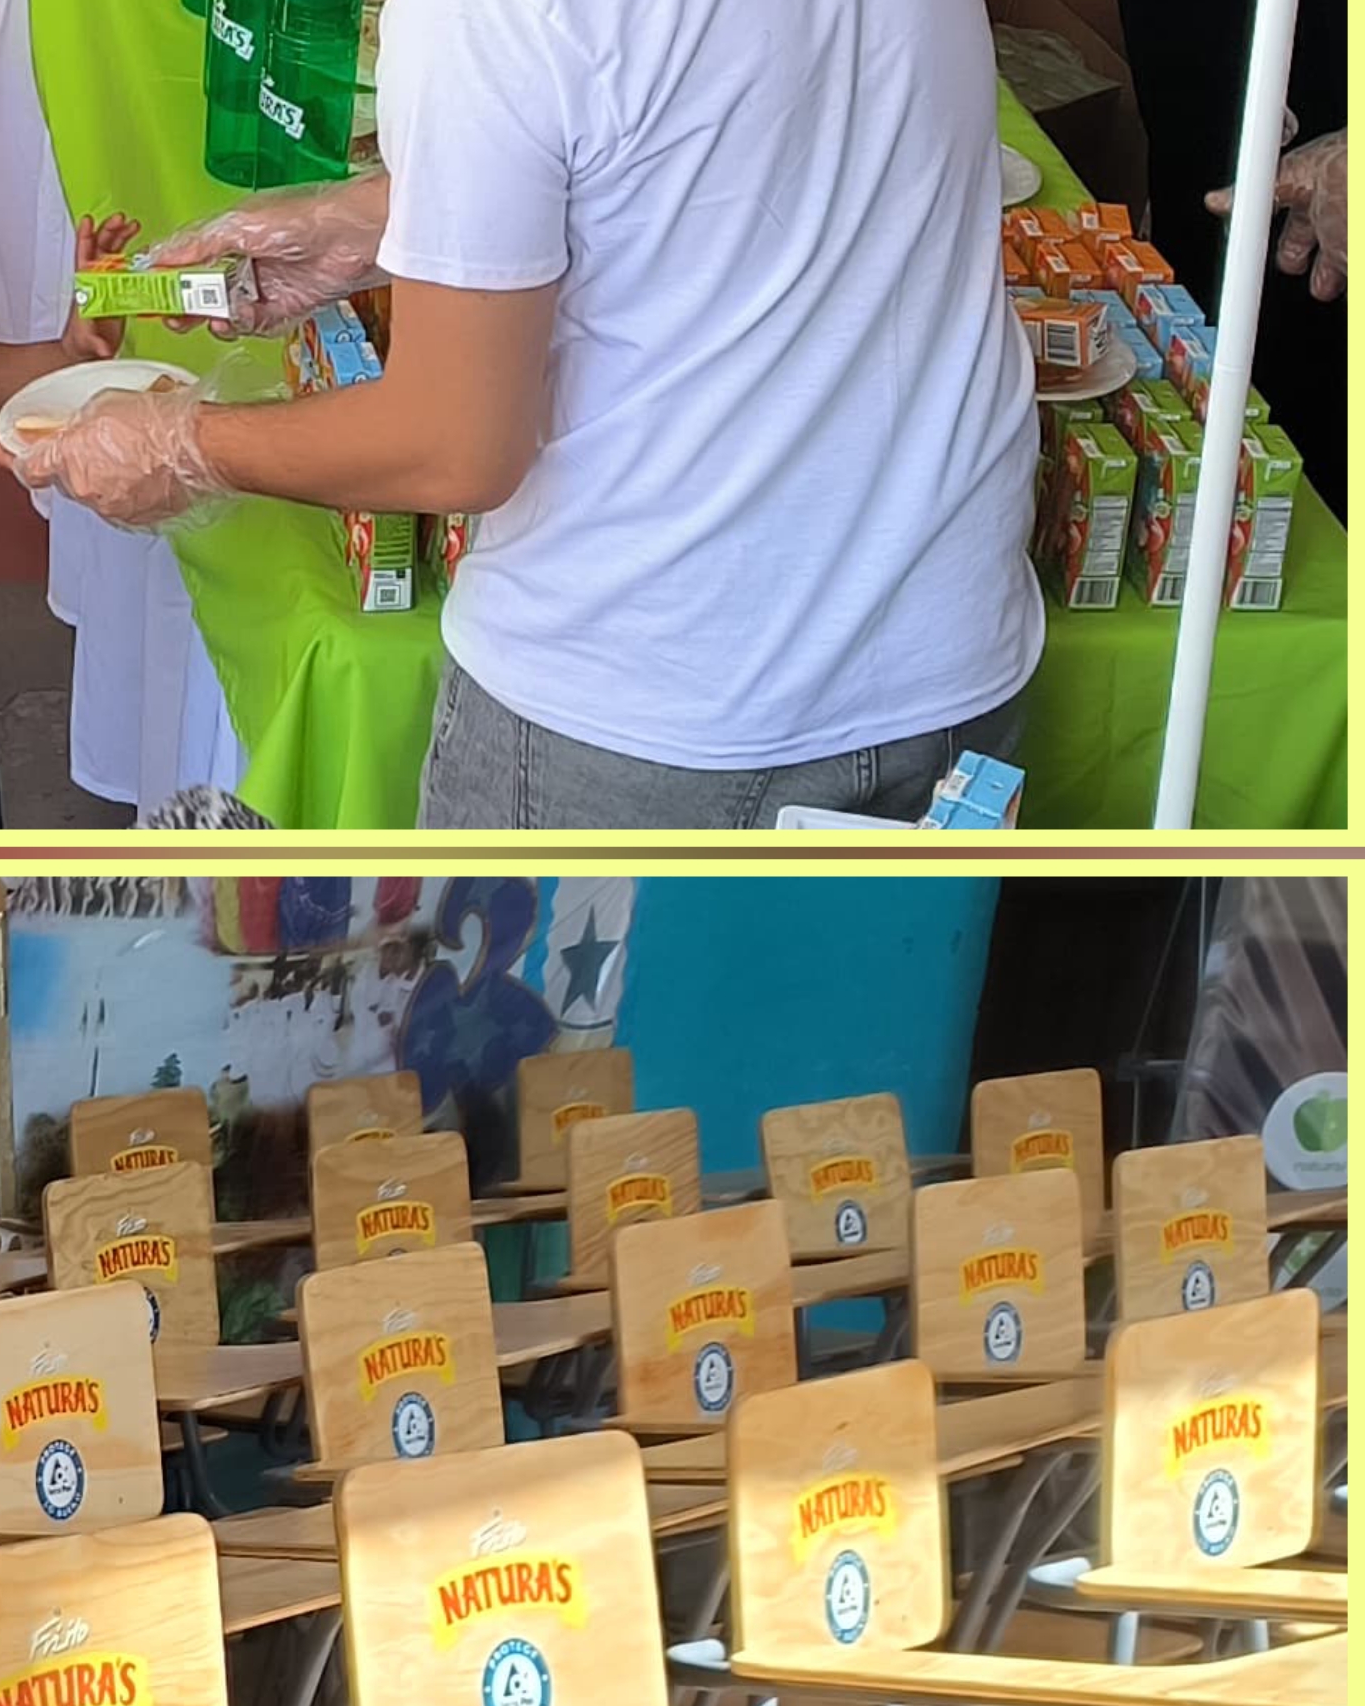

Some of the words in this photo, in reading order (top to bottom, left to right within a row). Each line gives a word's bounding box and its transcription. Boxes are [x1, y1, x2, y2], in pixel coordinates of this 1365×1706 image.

[98, 1241, 172, 1275] NATURA'S
[364, 1336, 446, 1385] NATURA'S
[6, 1385, 99, 1430] NATURA'S
[1174, 1405, 1264, 1458] NATURA'S
[799, 1478, 886, 1538] NATURA'S
[439, 1559, 572, 1625] NATURA'S
